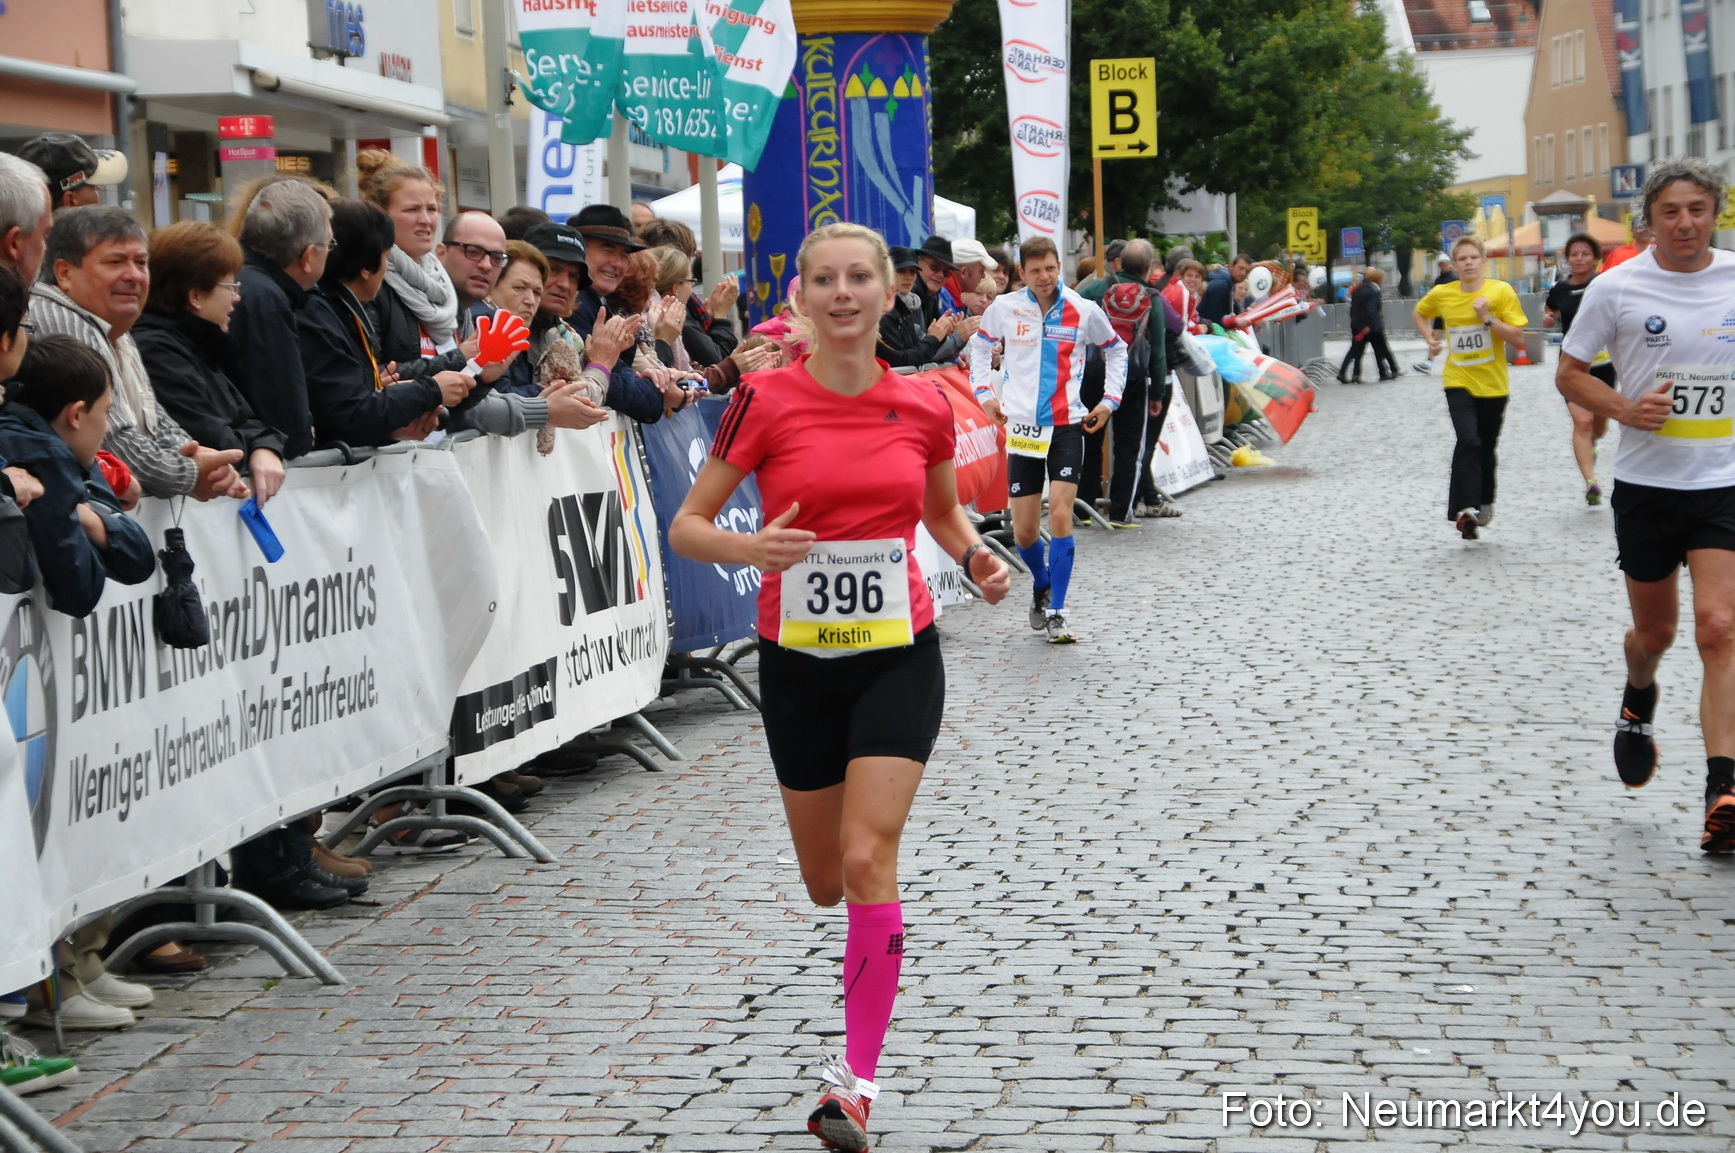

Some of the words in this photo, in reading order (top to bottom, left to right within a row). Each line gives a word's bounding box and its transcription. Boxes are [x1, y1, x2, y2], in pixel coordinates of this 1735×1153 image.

[1098, 63, 1148, 81] Block
[1108, 88, 1140, 135] B
[228, 147, 256, 157] HotSpot
[1292, 209, 1314, 218] Block
[1296, 220, 1311, 242] C
[1457, 333, 1484, 350] 440
[1646, 335, 1671, 344] PARTL
[1656, 371, 1686, 380] PARTL
[1689, 373, 1730, 381] Neumarkt
[1671, 384, 1727, 416] 573
[1011, 438, 1040, 451] Benjamin
[827, 552, 885, 565] Neumarkt
[806, 569, 884, 615] 396
[817, 626, 872, 644] Kristin
[70, 598, 146, 724] BMW
[68, 742, 151, 827] Weniger
[154, 699, 236, 789] Verbrauch.
[280, 655, 379, 736] Fahrfreude.
